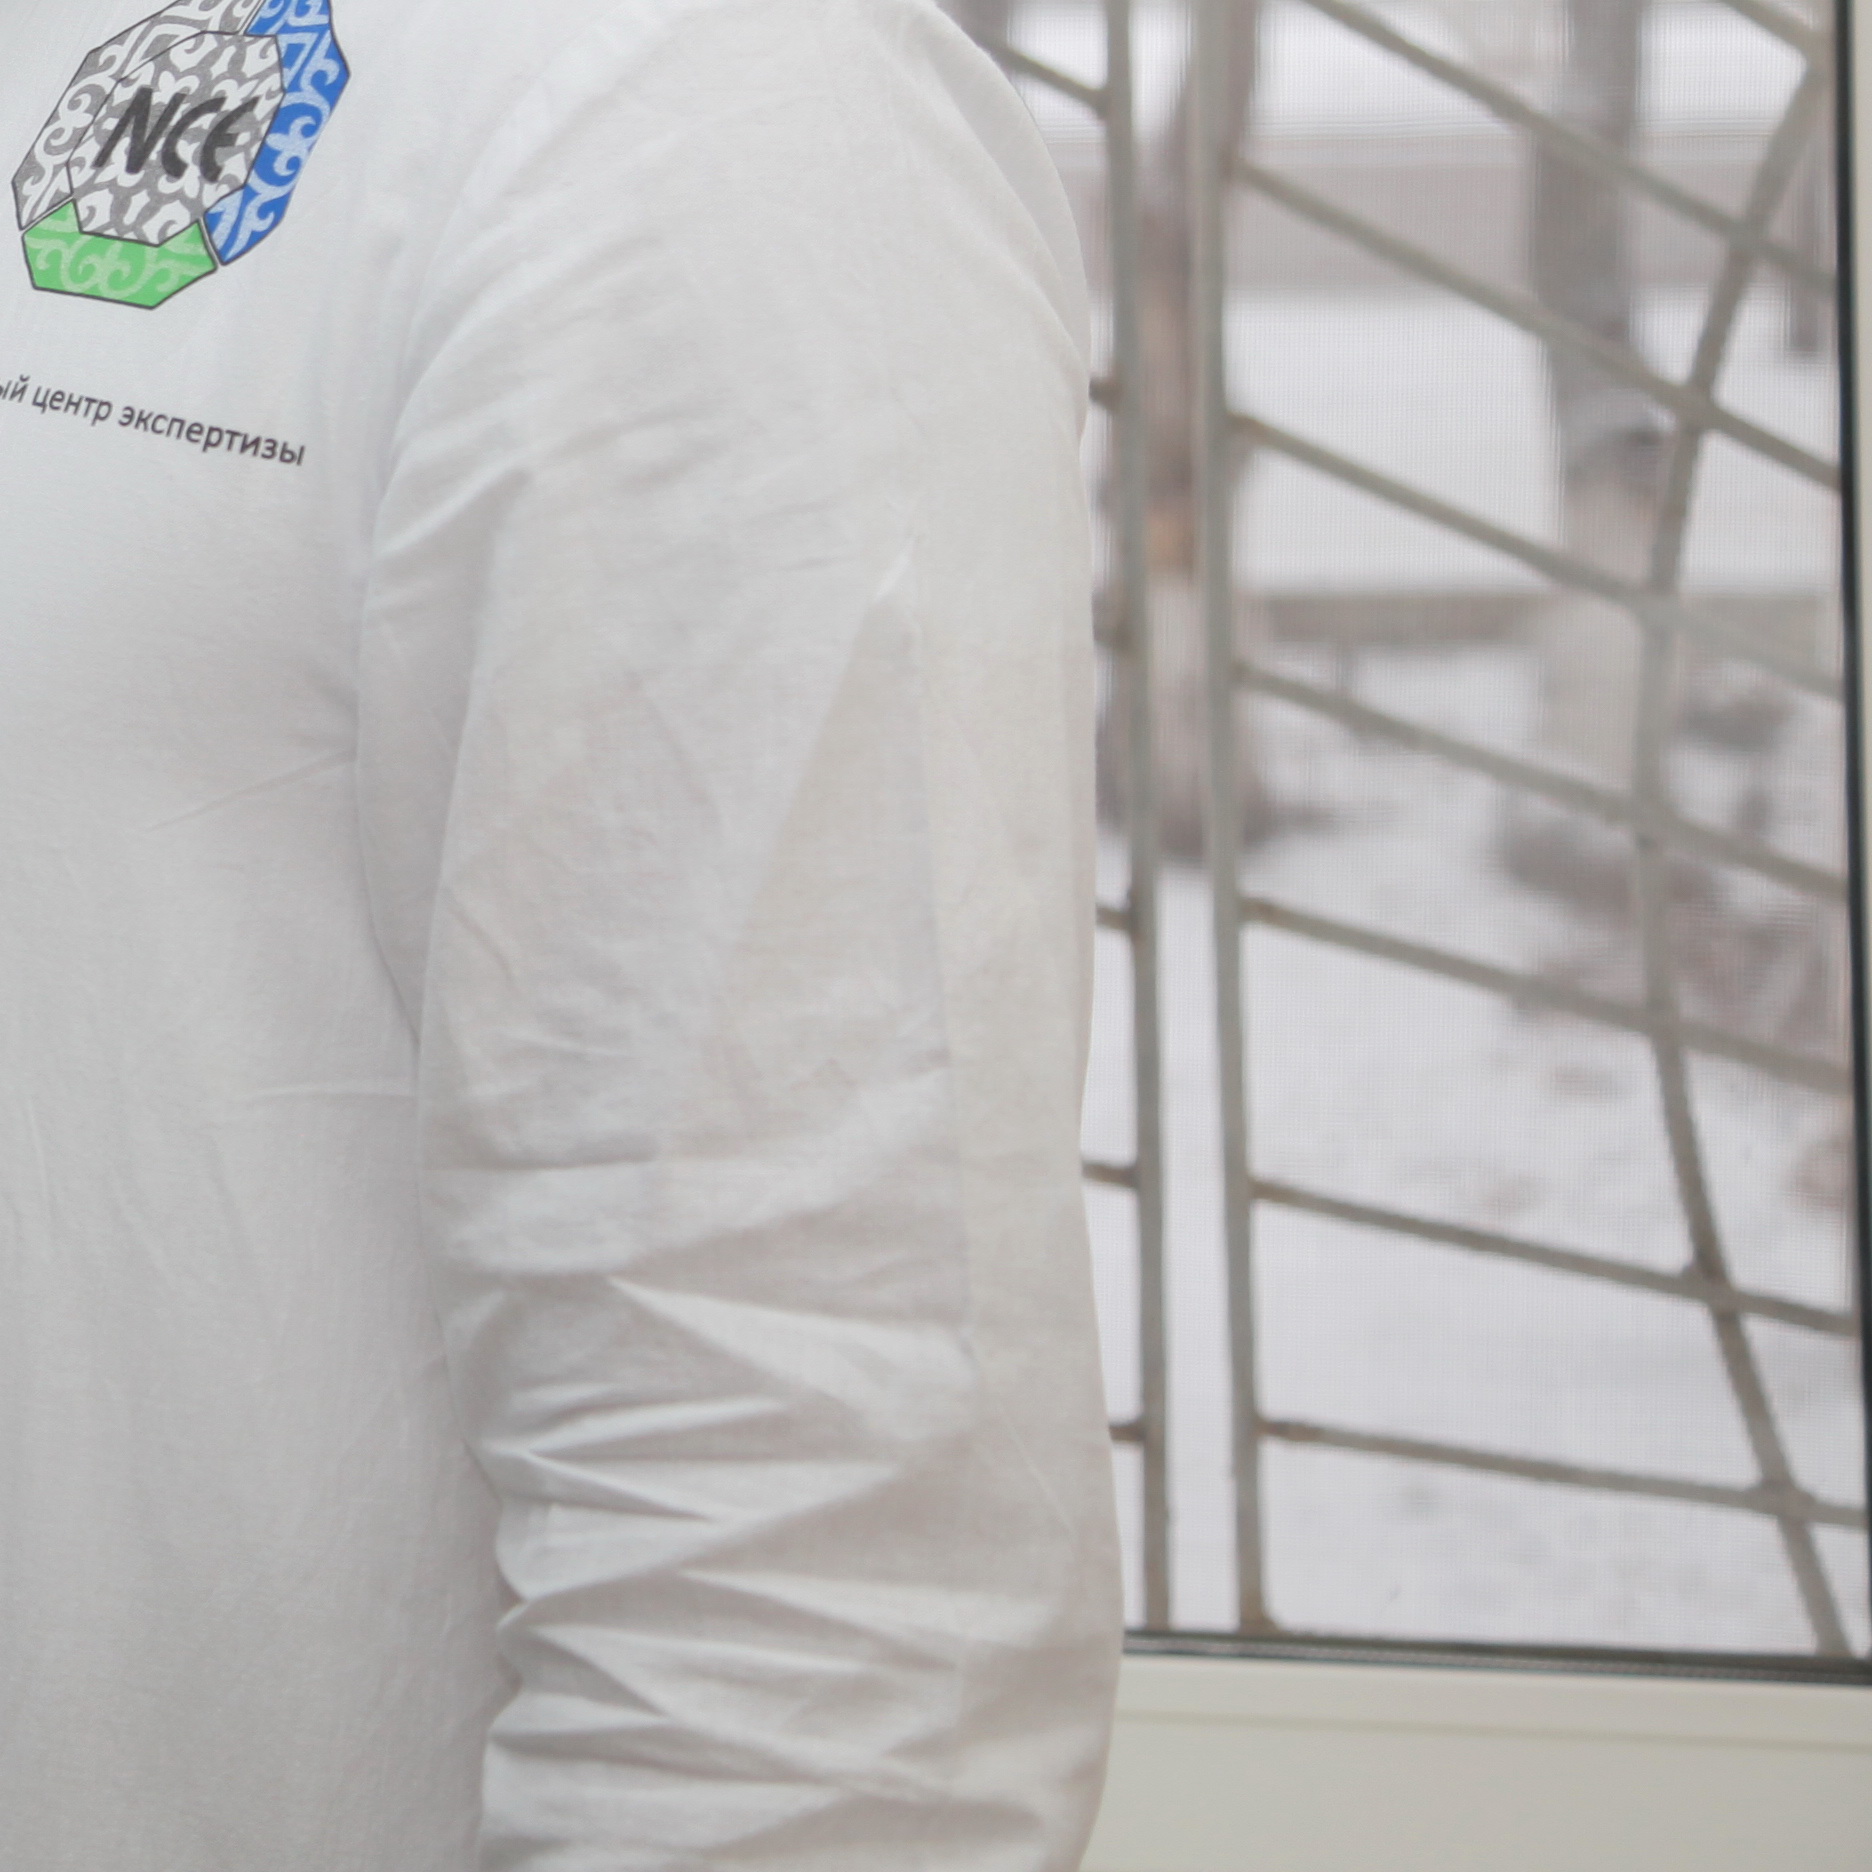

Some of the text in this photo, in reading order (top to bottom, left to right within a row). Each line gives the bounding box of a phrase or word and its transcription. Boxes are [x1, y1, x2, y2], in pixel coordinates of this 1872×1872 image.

[91, 86, 260, 183] NCE
[31, 382, 113, 427] центр
[118, 402, 306, 467] экспертизы
